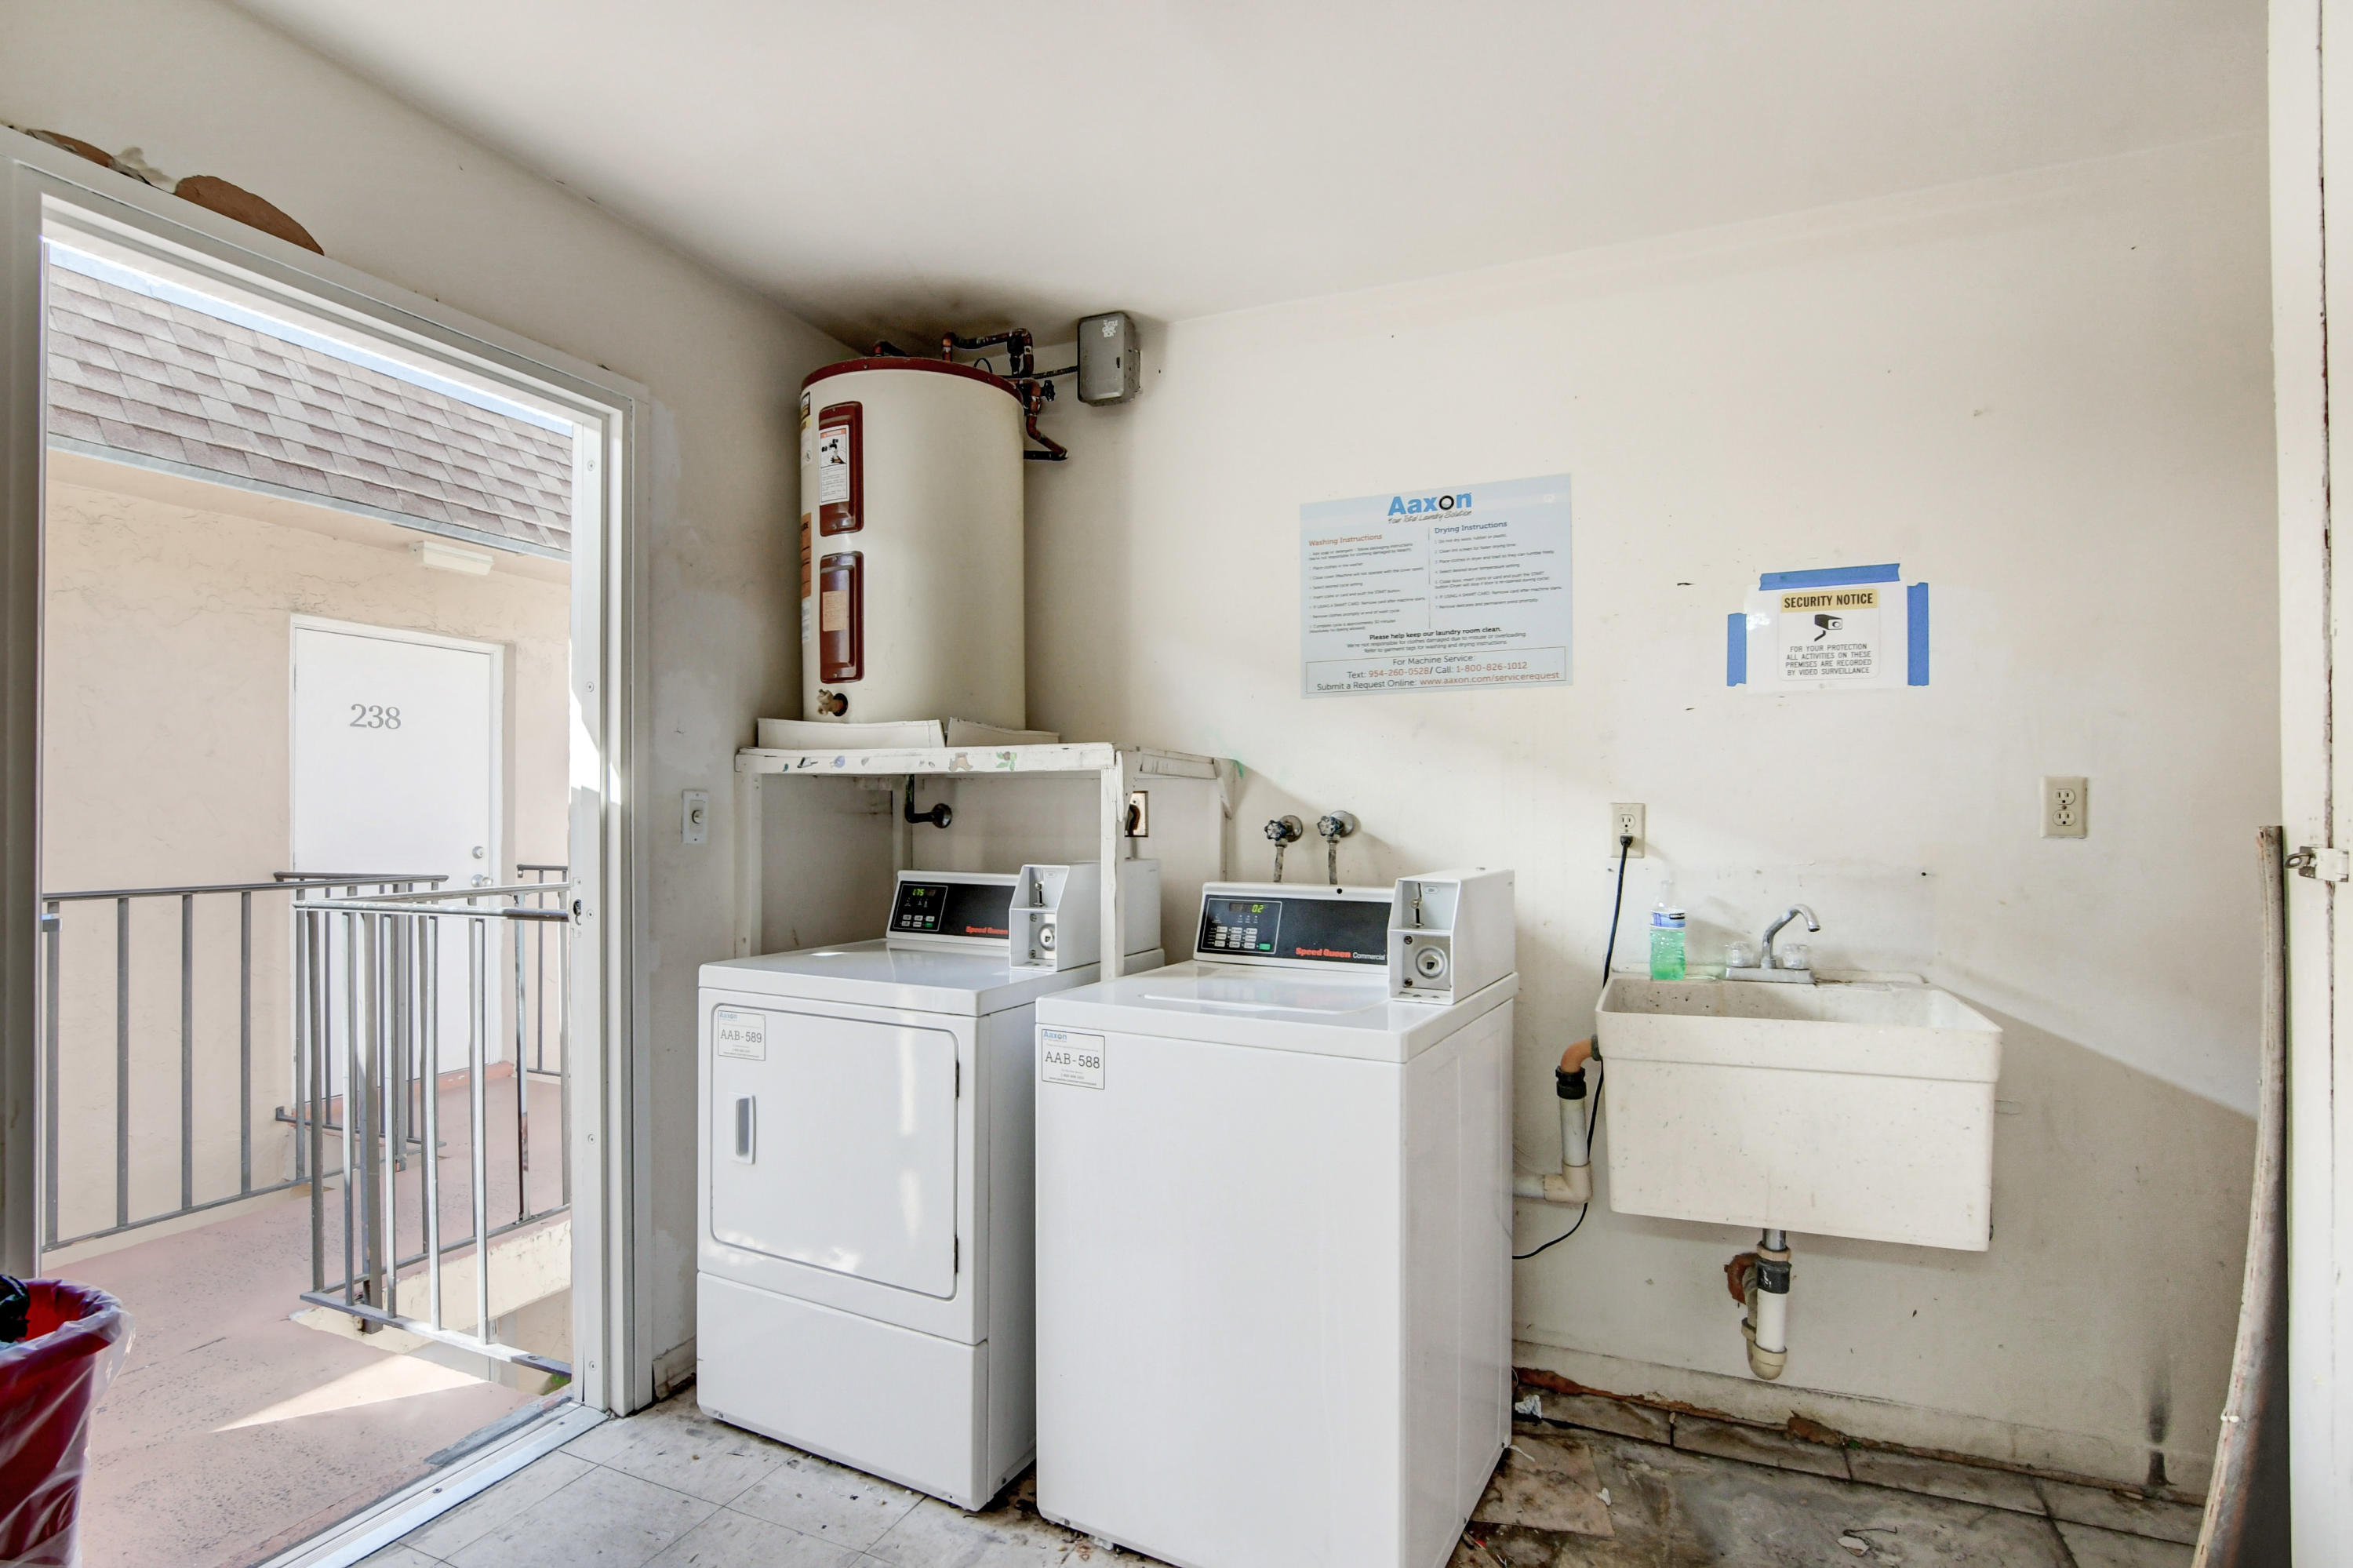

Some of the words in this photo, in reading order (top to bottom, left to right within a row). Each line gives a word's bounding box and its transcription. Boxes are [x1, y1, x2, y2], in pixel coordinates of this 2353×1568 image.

[1387, 493, 1472, 516] Aaxon
[1461, 522, 1507, 531] Instructions
[1340, 534, 1382, 543] Instructions
[1784, 595, 1832, 609] SECURITY
[1836, 593, 1873, 605] NOTICE
[1456, 662, 1528, 673] 1-800-826-1012
[1353, 681, 1384, 689] Request
[1420, 672, 1559, 686] www.aaxon.com/servicerequest
[350, 704, 402, 729] 238
[1251, 904, 1264, 913] 02
[966, 926, 987, 934] Speed
[1296, 948, 1323, 956] Speed
[1323, 948, 1351, 959] Queen
[1352, 951, 1386, 961] Commercial
[720, 1029, 762, 1043] AAB-589
[1043, 1030, 1067, 1039] Aaxon
[1045, 1051, 1100, 1069] AAB-588
